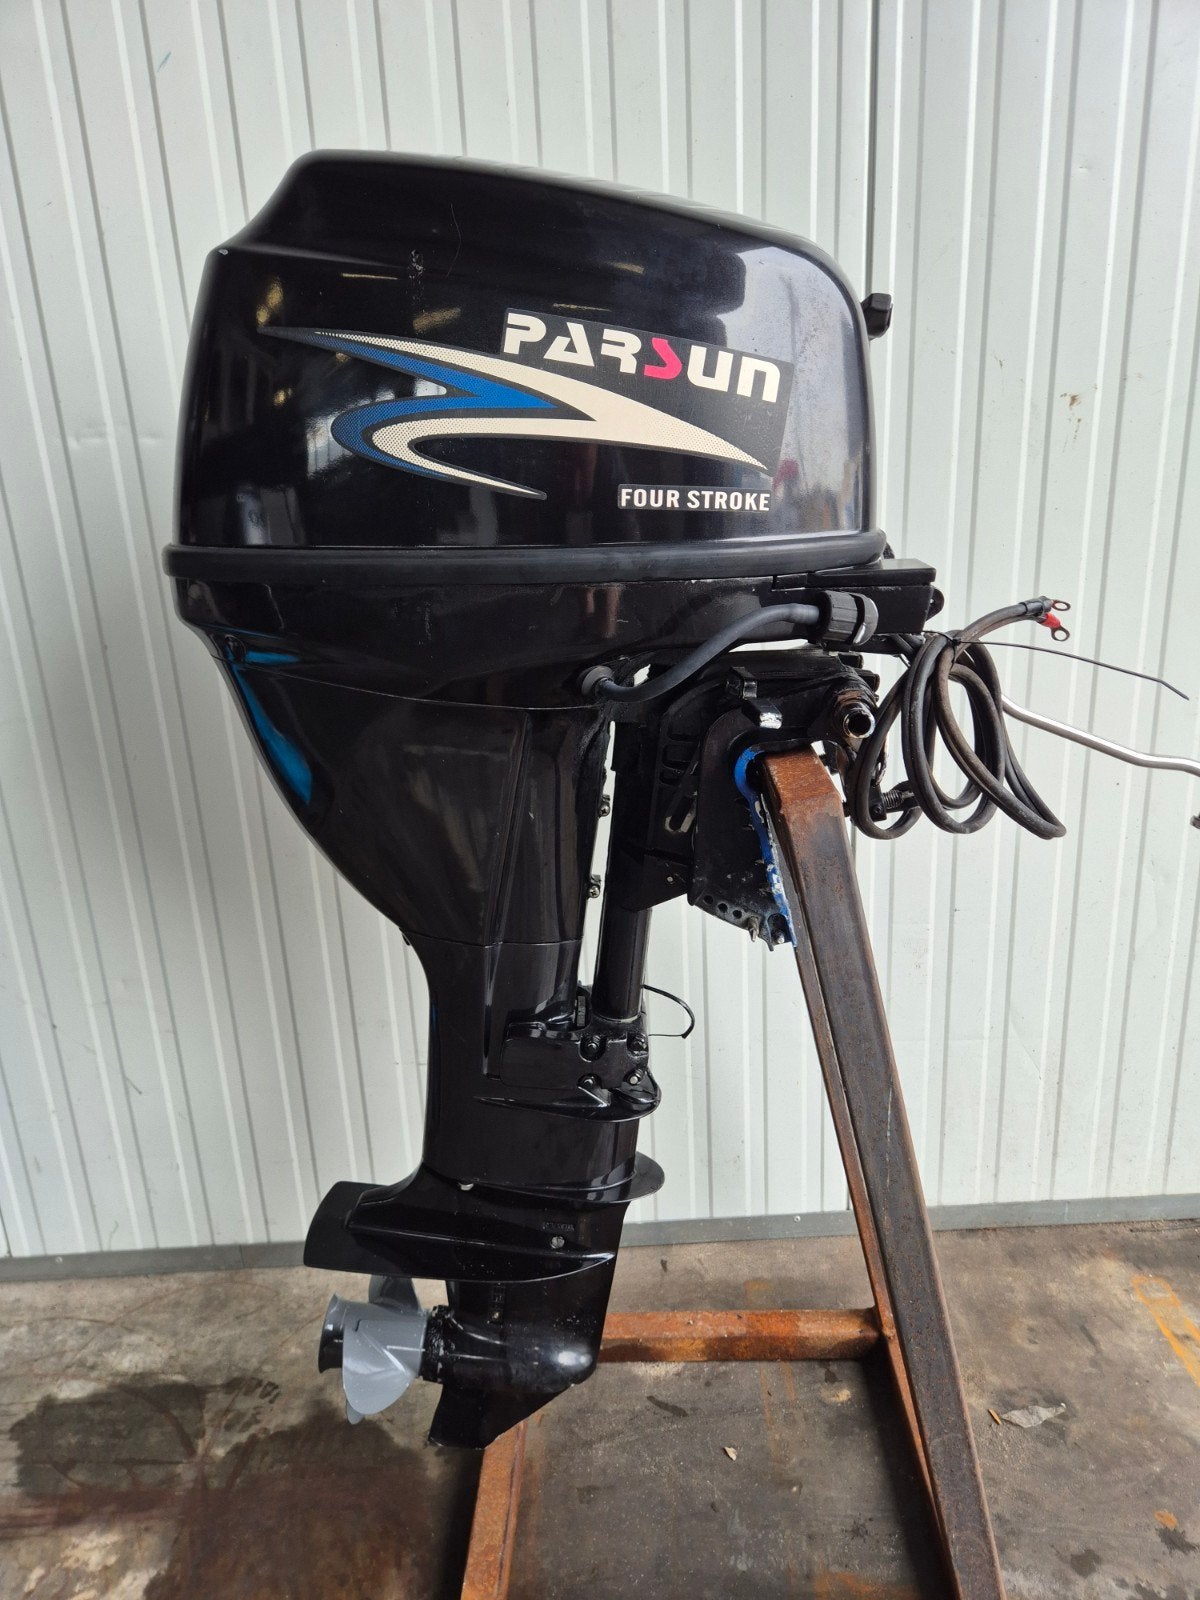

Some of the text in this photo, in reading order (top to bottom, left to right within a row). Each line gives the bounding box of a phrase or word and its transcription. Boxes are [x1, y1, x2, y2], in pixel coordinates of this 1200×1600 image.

[503, 312, 781, 403] PARSUN
[620, 488, 771, 512] FOUR STROKE
